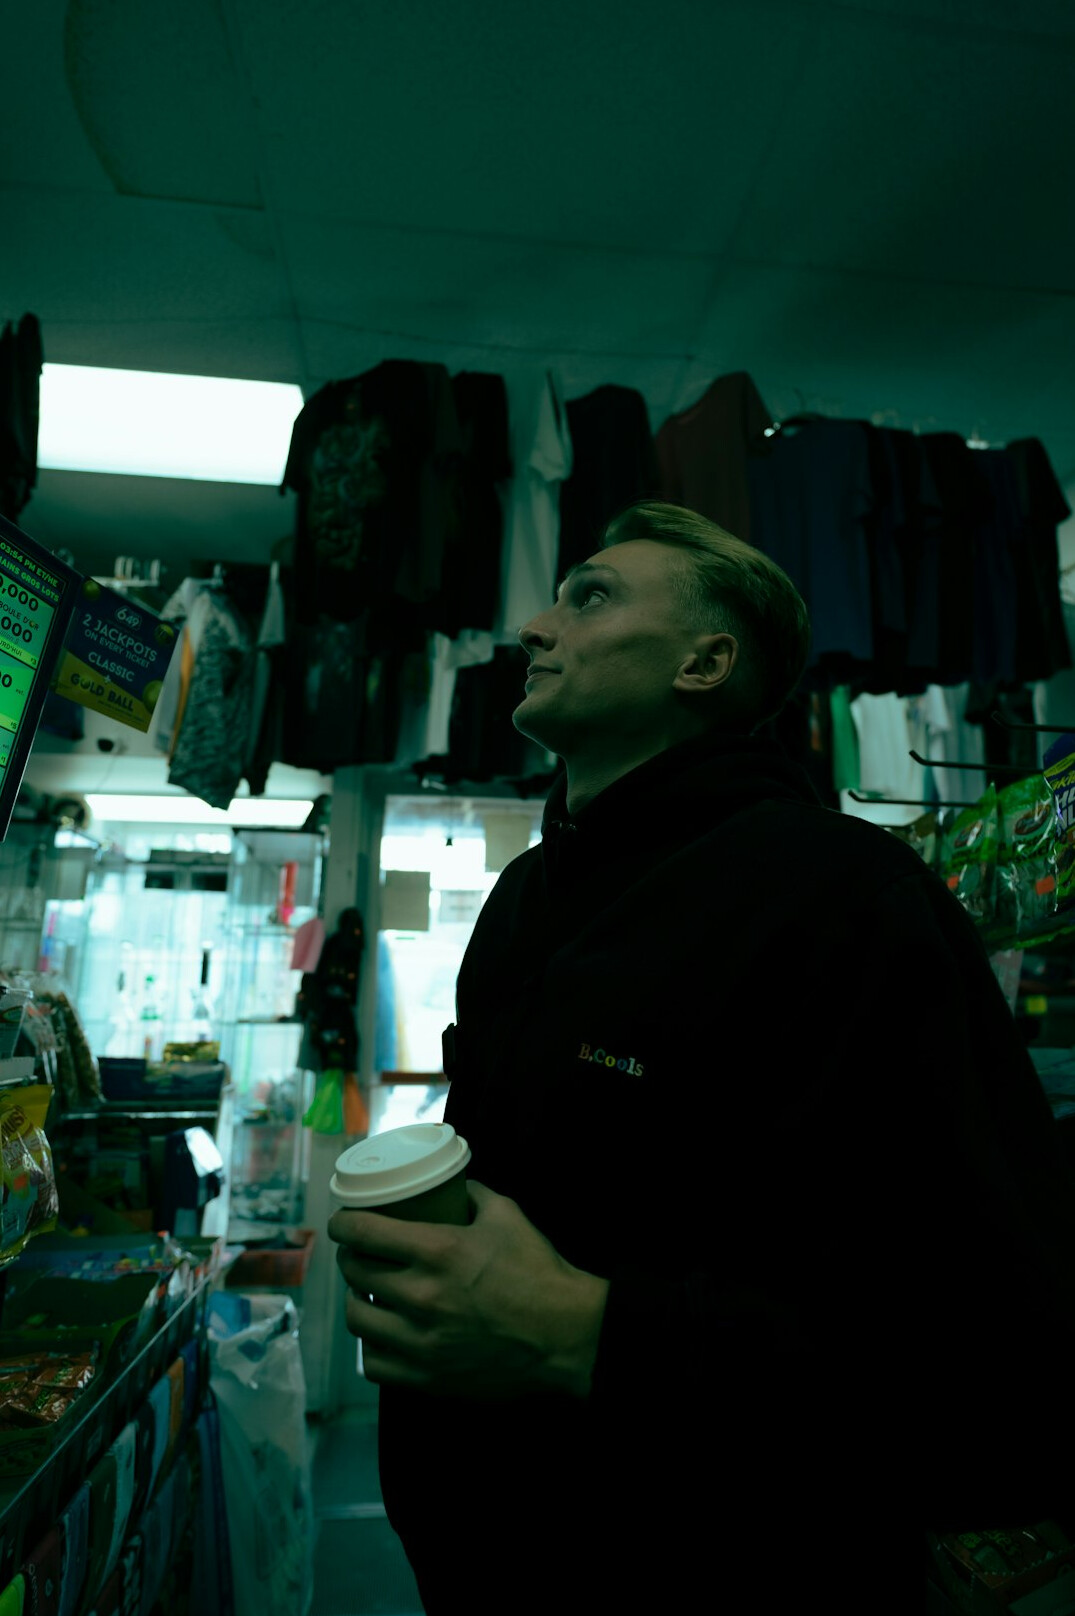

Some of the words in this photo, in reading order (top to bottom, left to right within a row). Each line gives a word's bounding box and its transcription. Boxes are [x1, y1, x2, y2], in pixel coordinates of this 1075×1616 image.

[24, 558, 36, 573] PM
[21, 571, 41, 590] GROS
[41, 585, 60, 602] LOTS
[82, 613, 92, 627] 2
[94, 619, 158, 662] JACKPOTS
[84, 629, 98, 641] ON
[99, 637, 124, 654] EVERY
[125, 650, 150, 669] TICKET
[88, 651, 135, 682] CLASSIC
[70, 673, 105, 696] GOLD
[108, 690, 134, 711] BALL
